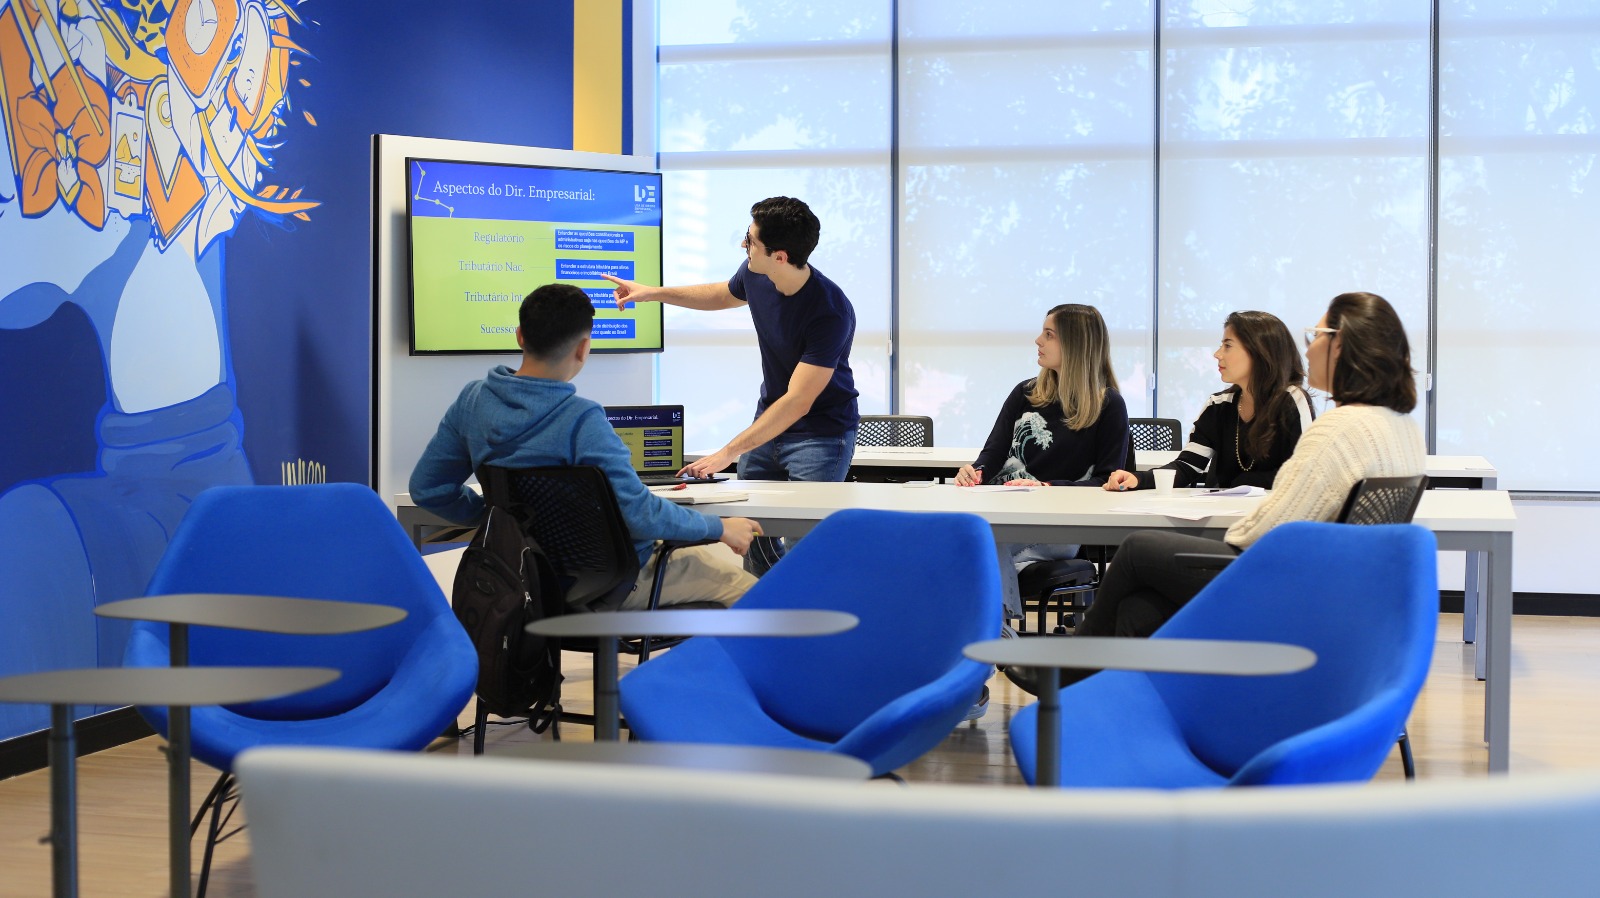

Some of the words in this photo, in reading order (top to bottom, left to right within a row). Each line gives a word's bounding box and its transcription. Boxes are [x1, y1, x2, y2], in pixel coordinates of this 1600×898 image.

[433, 181, 485, 196] Aspectos
[488, 183, 502, 196] do
[505, 184, 526, 197] Dir.
[529, 185, 596, 201] Empresarial:
[474, 231, 525, 245] Regulatório
[459, 260, 504, 272] Tributário
[505, 261, 525, 272] Nac.
[464, 291, 509, 302] Tributário
